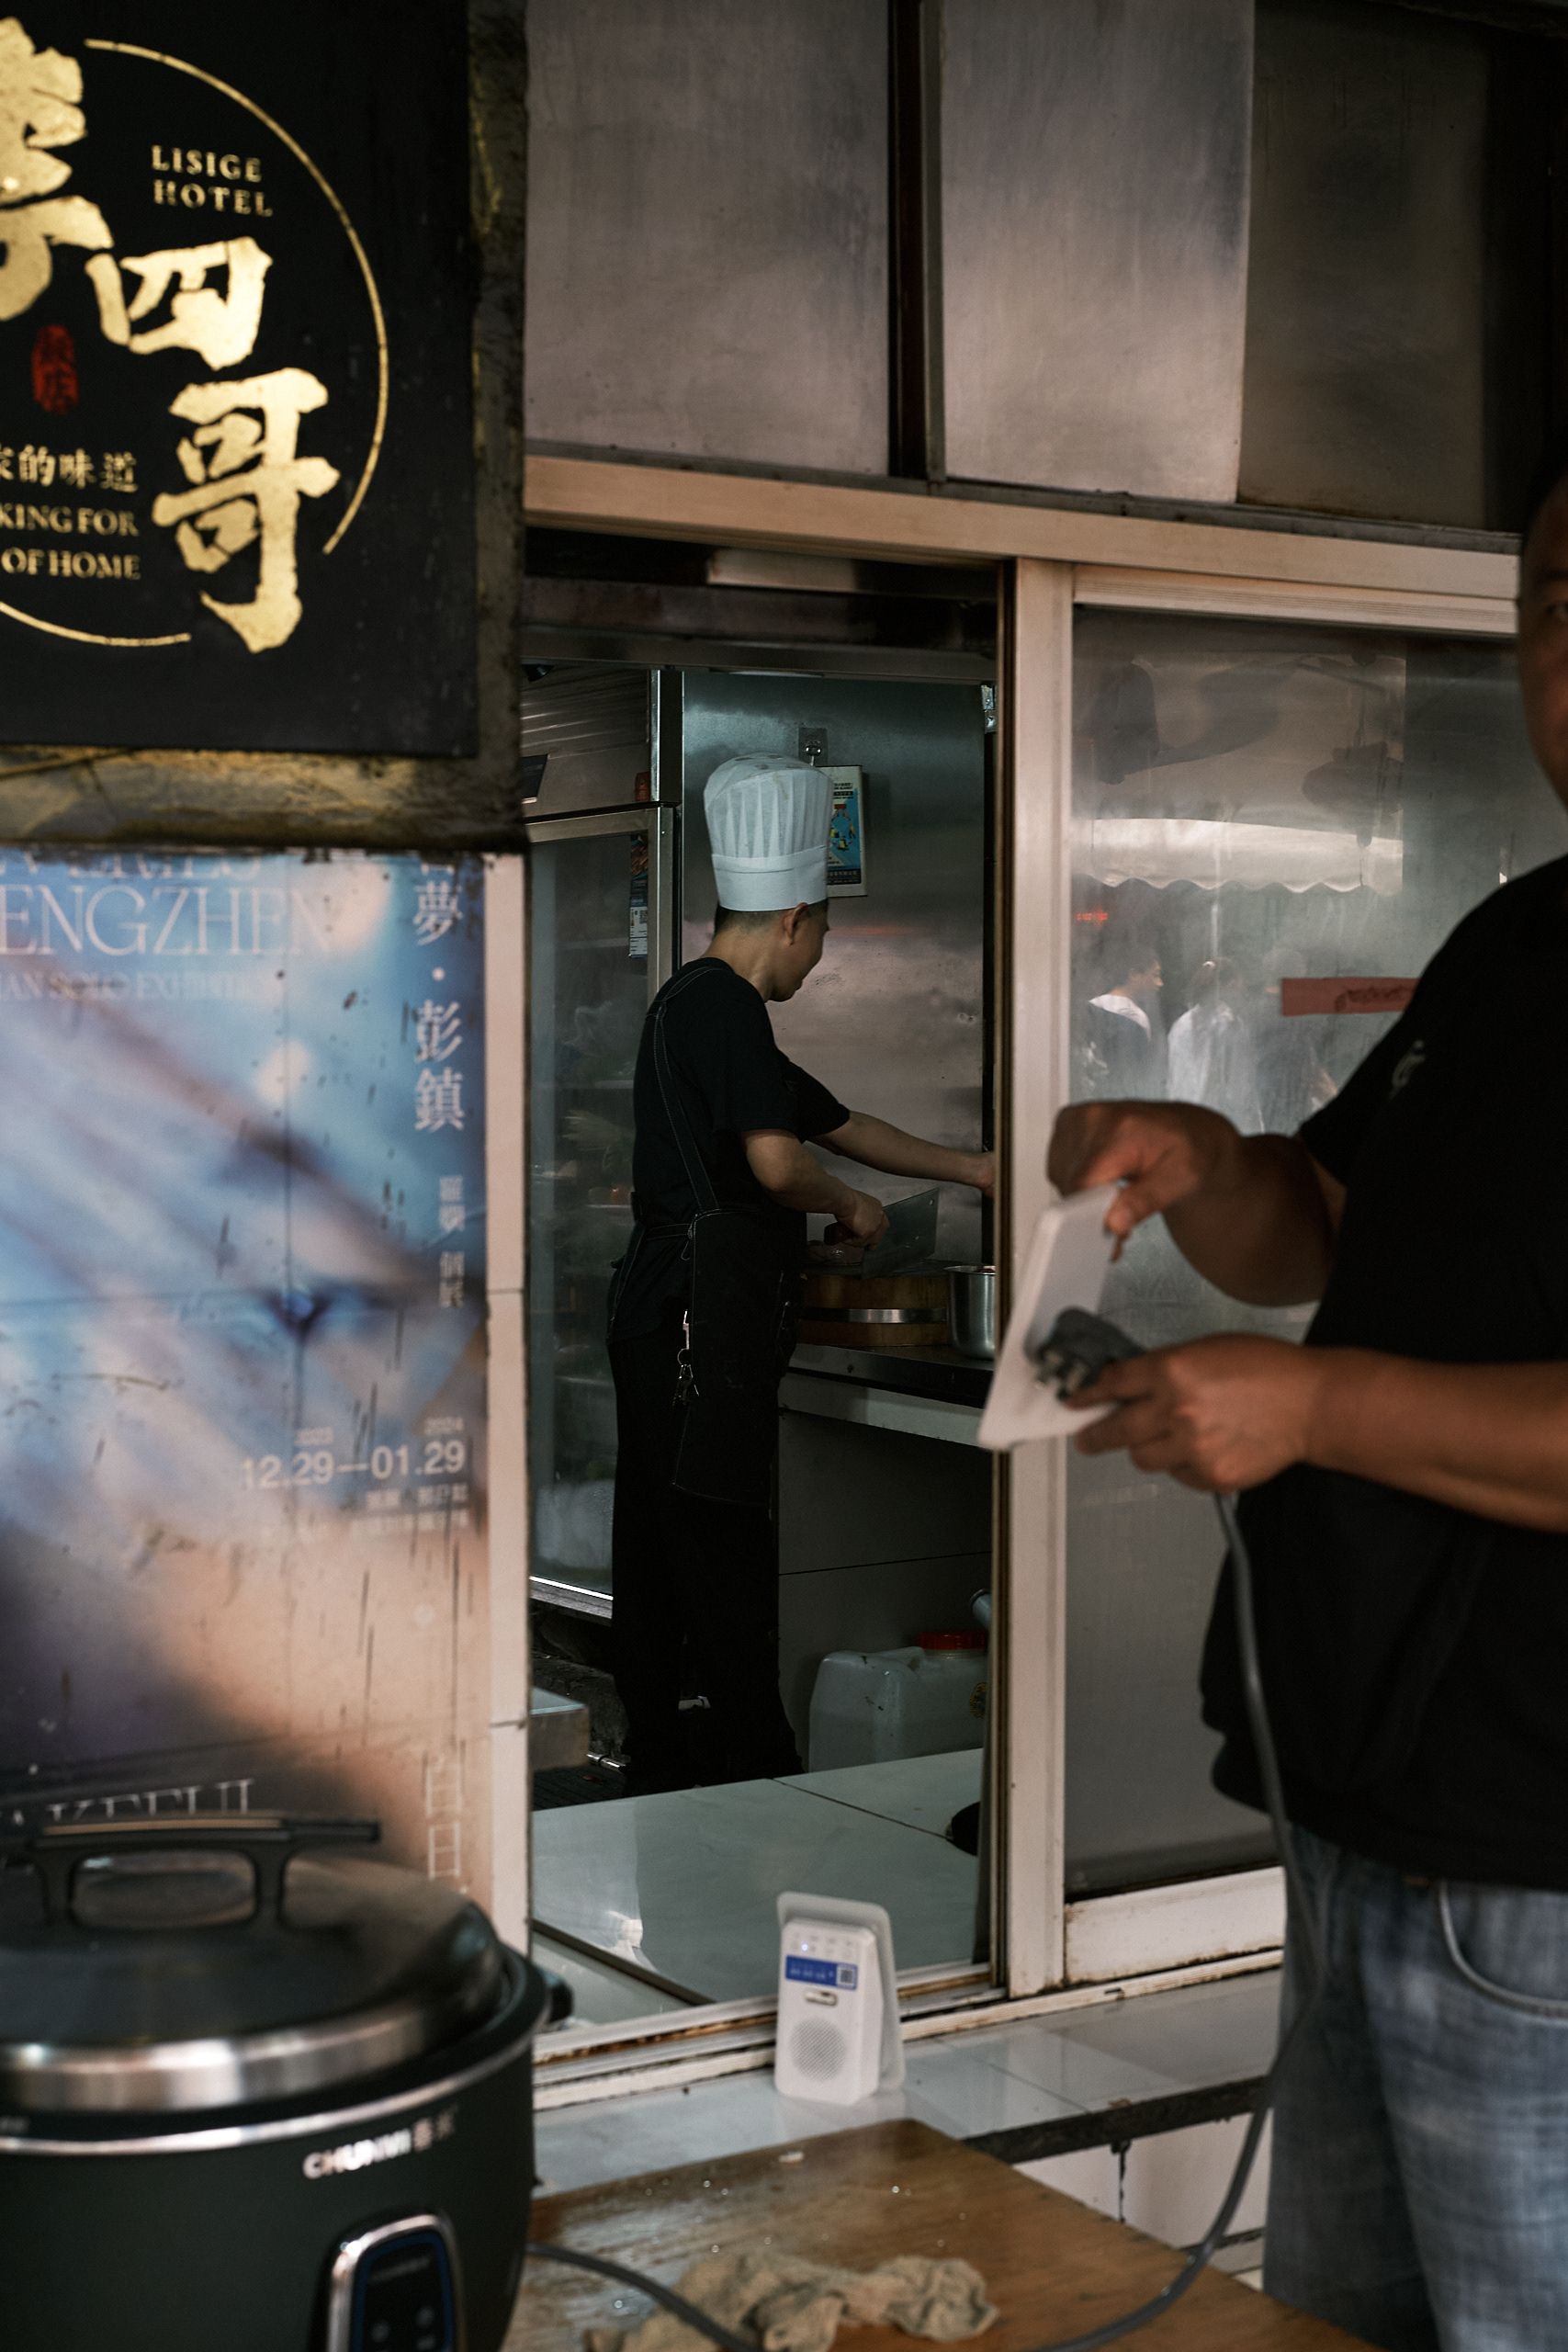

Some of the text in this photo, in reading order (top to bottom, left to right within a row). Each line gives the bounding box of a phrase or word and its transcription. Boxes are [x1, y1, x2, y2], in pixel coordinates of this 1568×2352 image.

[152, 144, 262, 182] LISIGE
[152, 179, 274, 217] HOTEL
[77, 507, 140, 537] FOR
[1, 547, 141, 580] OF HOME
